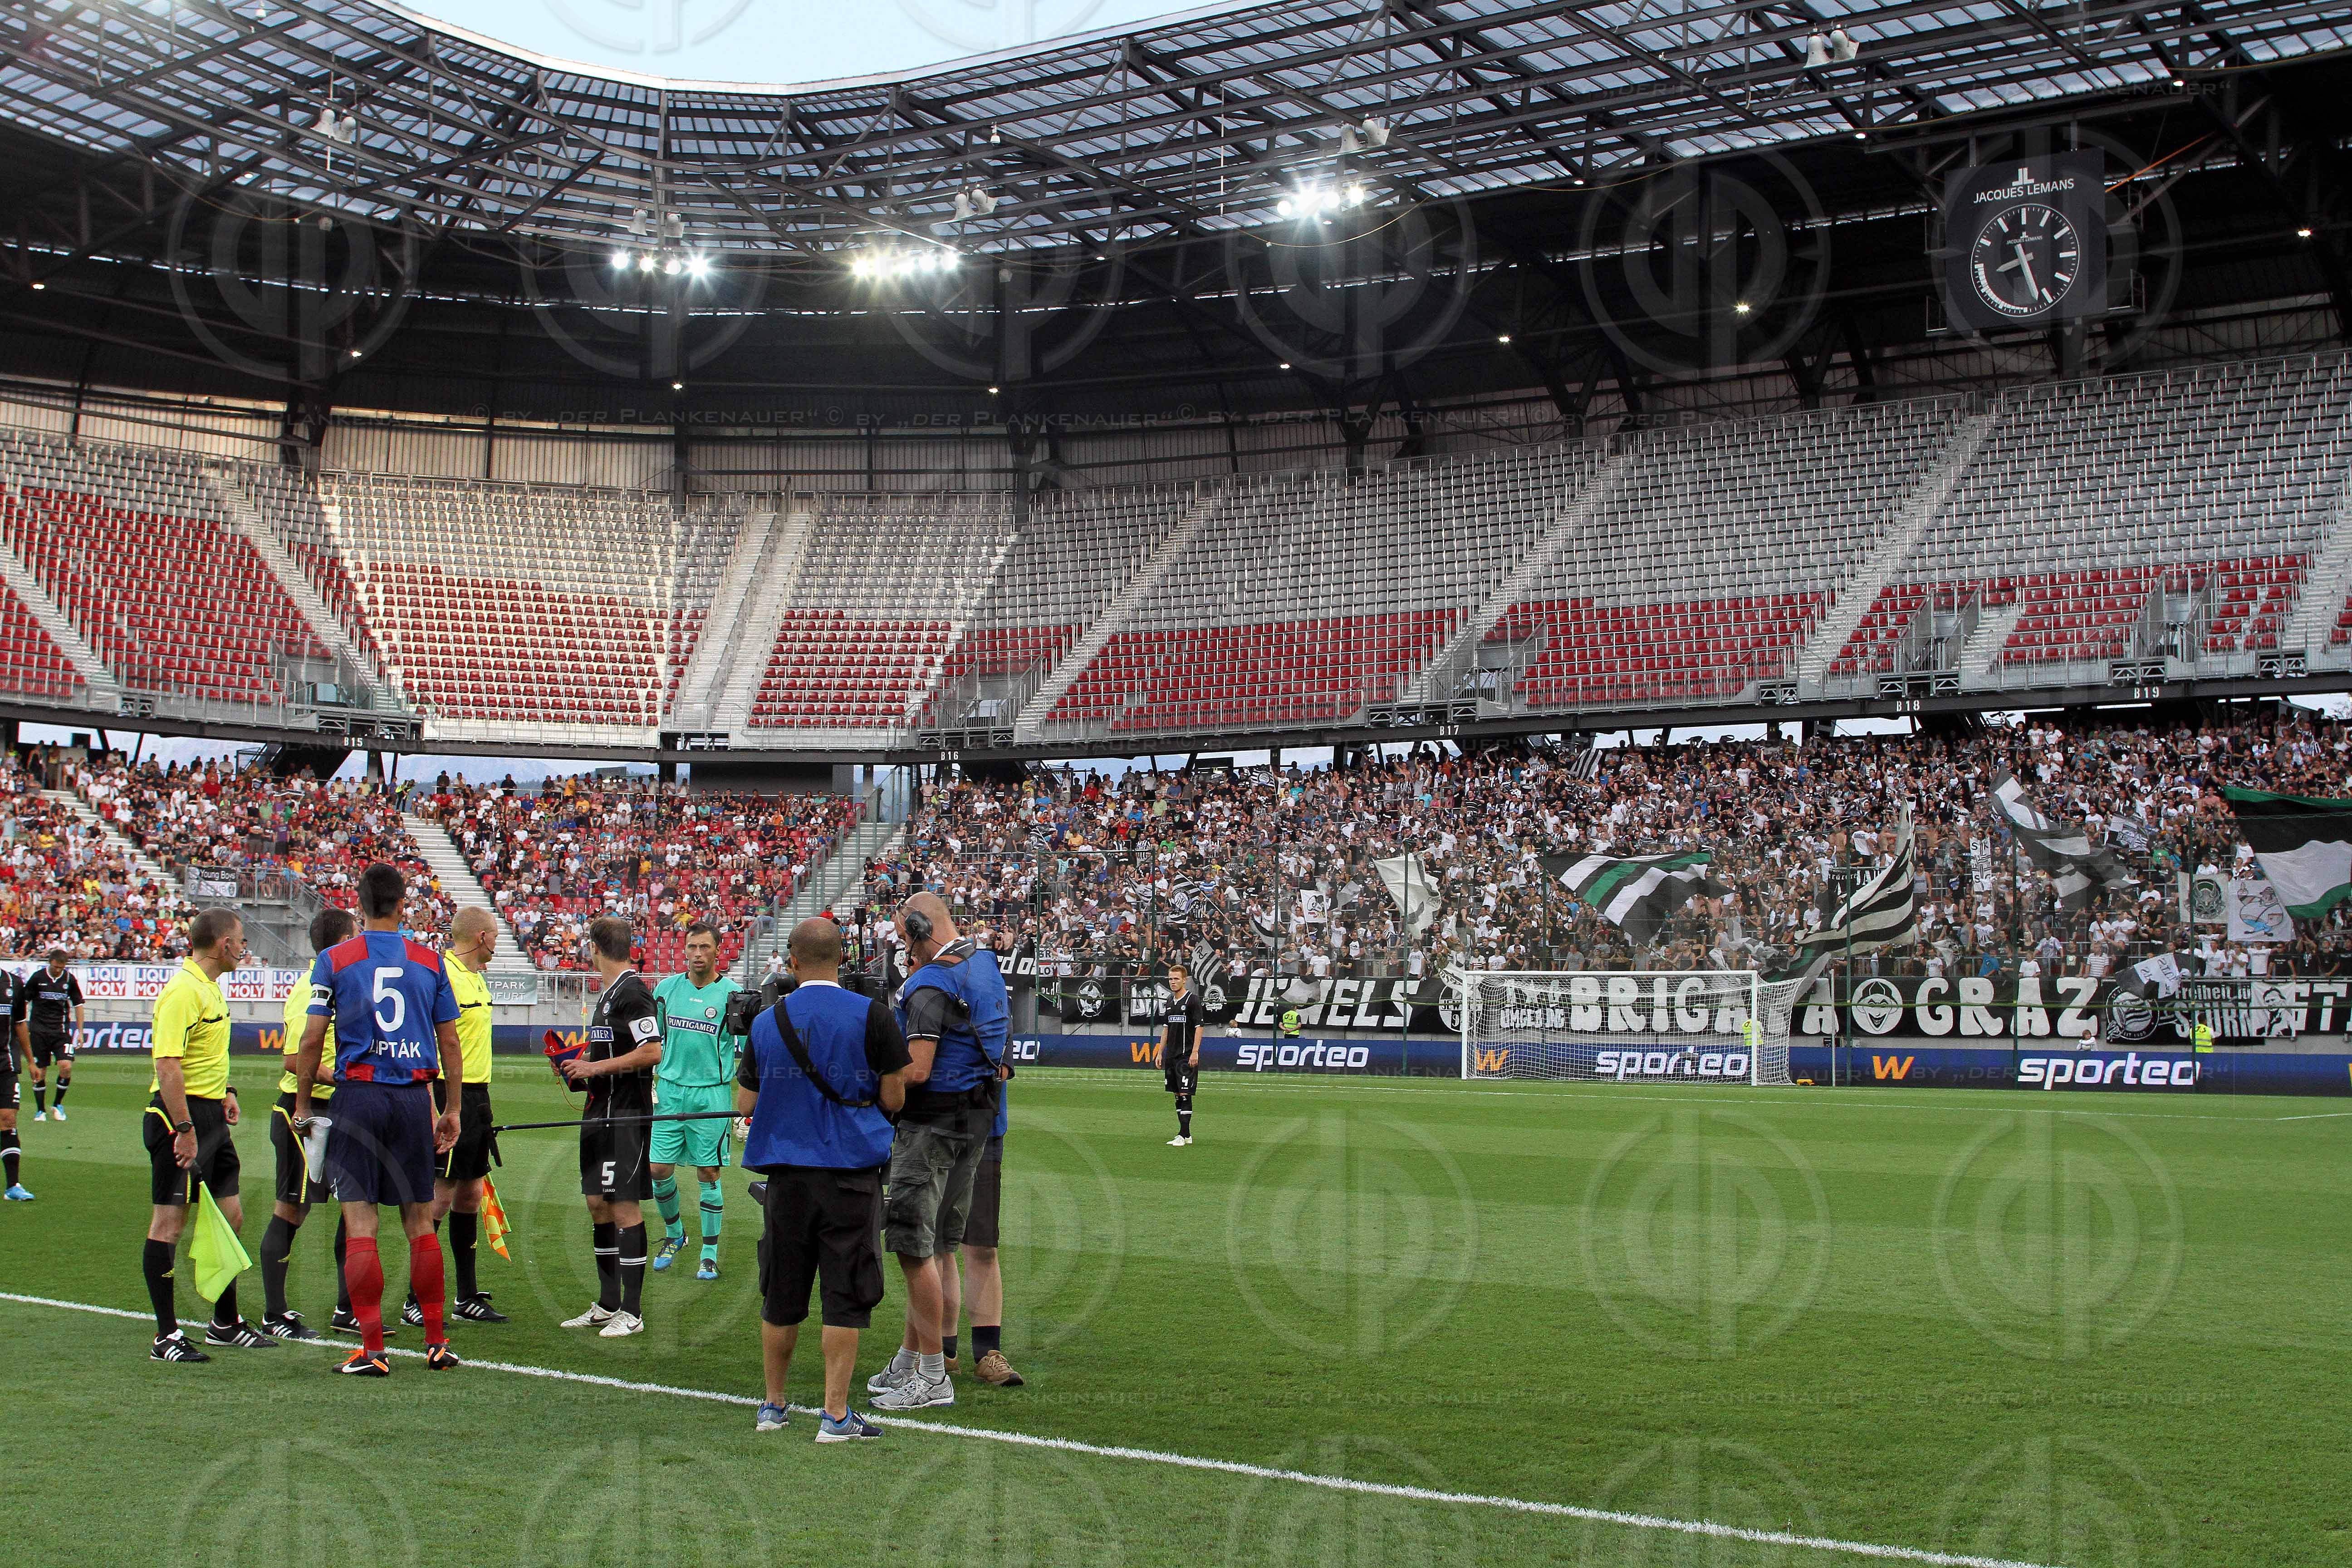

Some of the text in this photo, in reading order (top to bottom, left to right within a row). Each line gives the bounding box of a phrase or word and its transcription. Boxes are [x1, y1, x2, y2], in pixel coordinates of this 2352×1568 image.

[1974, 178, 2074, 204] JACQUES LEMANS
[200, 869, 235, 881] Young Boys
[87, 967, 126, 981] LIQUI
[228, 971, 264, 984] LIQUI
[87, 982, 126, 996] MOLY
[227, 984, 264, 998] MOLY
[487, 981, 526, 990] TPARK
[374, 967, 405, 1032] 5
[1235, 978, 1421, 1027] JEWELS
[1916, 977, 2098, 1037] GRAZ
[669, 1018, 715, 1033] PUNTIGAMER
[368, 1039, 421, 1058] LIPTÁK
[1236, 1039, 1369, 1072] sporteo
[1595, 1045, 1749, 1080] sporteo
[2018, 1052, 2200, 1090] sporteo
[1181, 1076, 1189, 1087] 4
[601, 1161, 616, 1186] 5
